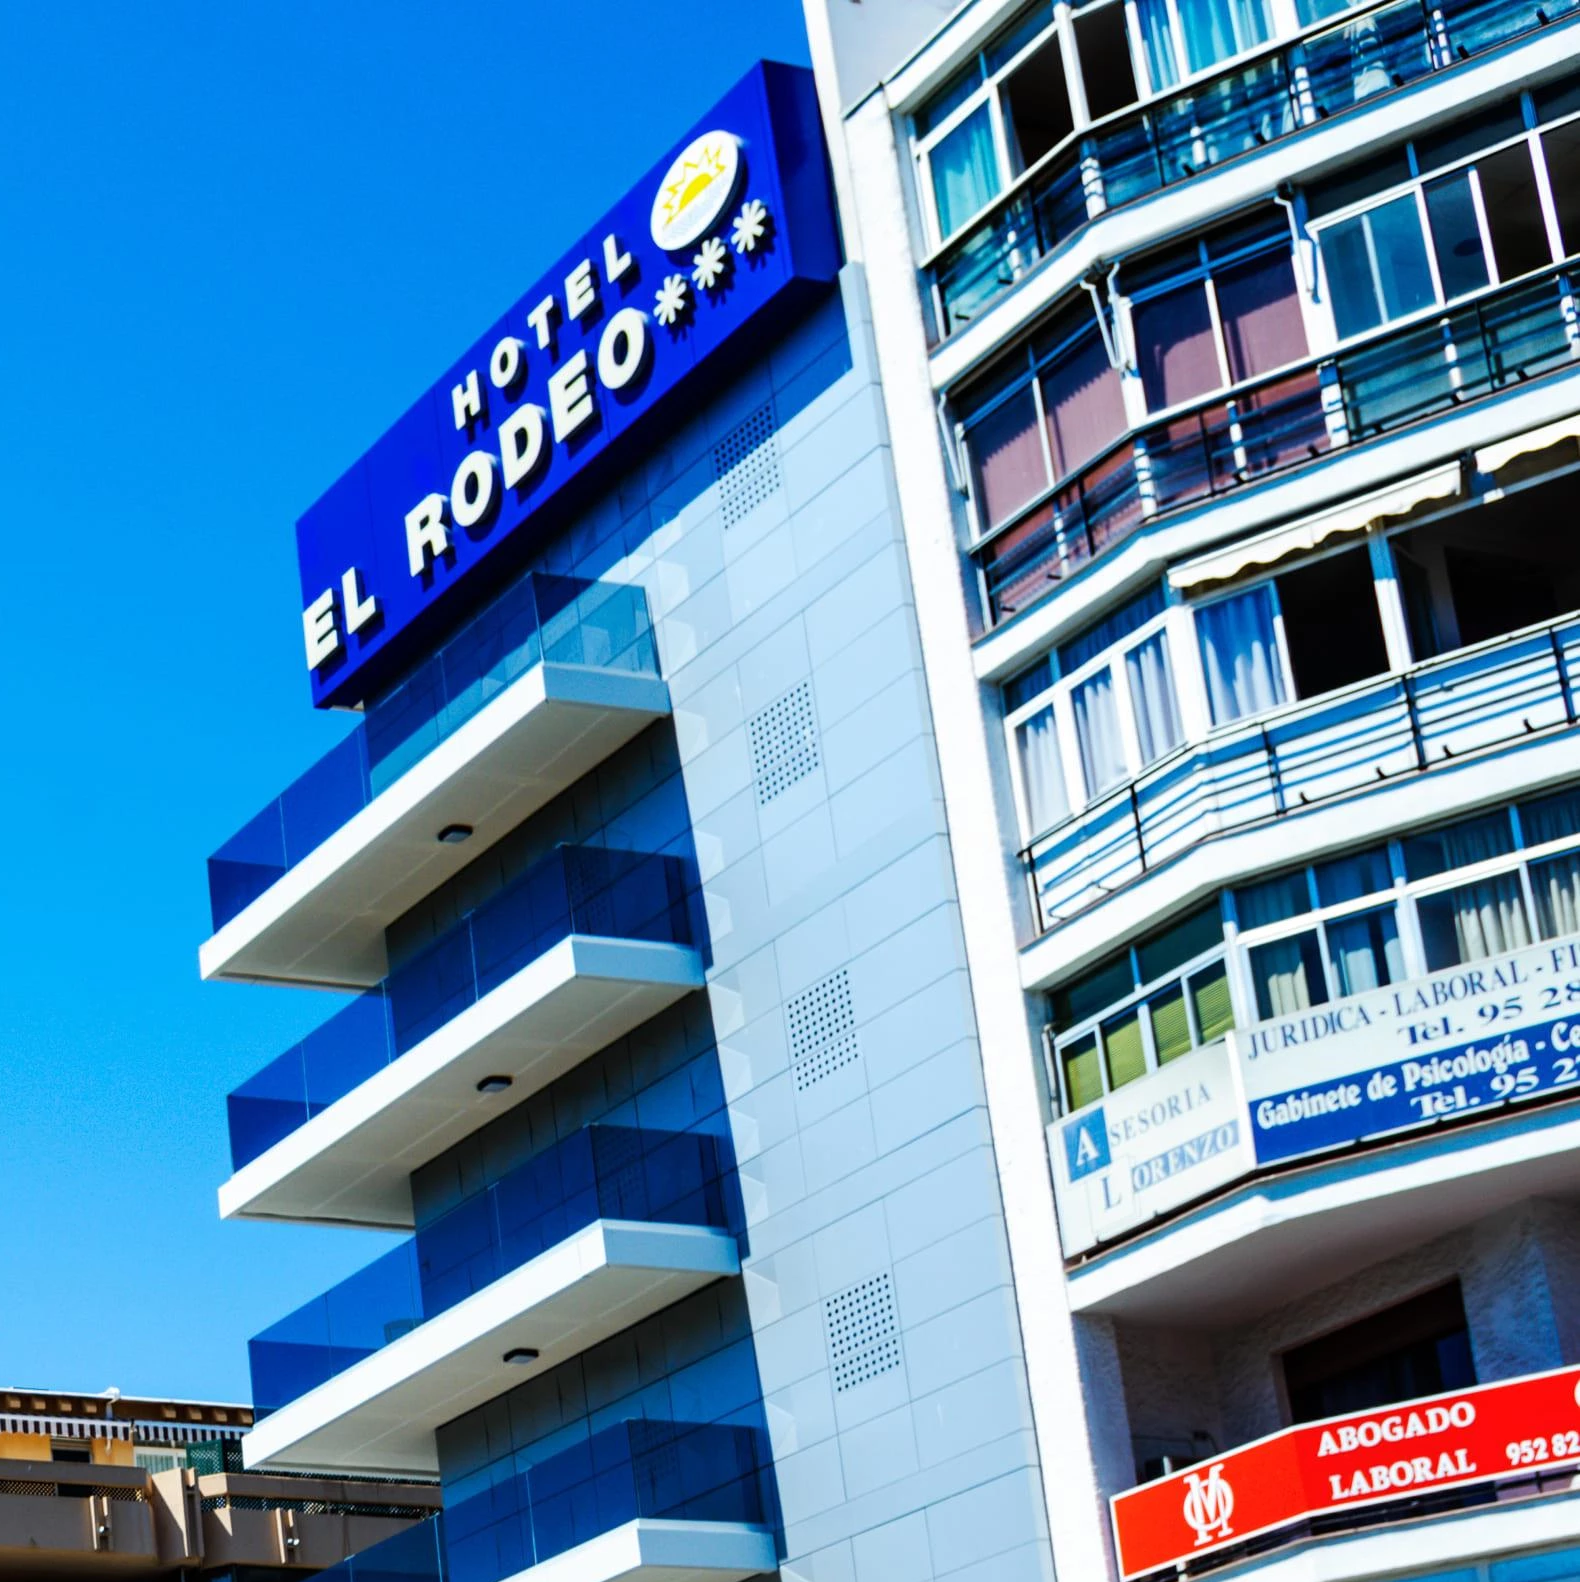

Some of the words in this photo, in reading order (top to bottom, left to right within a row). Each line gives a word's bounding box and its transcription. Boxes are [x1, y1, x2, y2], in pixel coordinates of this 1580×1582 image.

[452, 233, 632, 430] HOTEL
[302, 567, 377, 670] EL
[404, 307, 648, 577] RODEO
[1247, 1006, 1372, 1060] JURIDICA
[1393, 960, 1528, 1017] LABORAL
[1397, 1016, 1465, 1046] Tel.
[1478, 996, 1523, 1026] 95
[1257, 1082, 1362, 1130] Gabinete
[1367, 1071, 1398, 1101] de
[1401, 1034, 1530, 1092] Psicología
[1410, 1085, 1481, 1119] Tel.
[1490, 1066, 1540, 1099] 95
[1317, 1401, 1477, 1458] ABOGADO
[1329, 1449, 1477, 1501] LABORAL
[1505, 1437, 1550, 1466] 952
